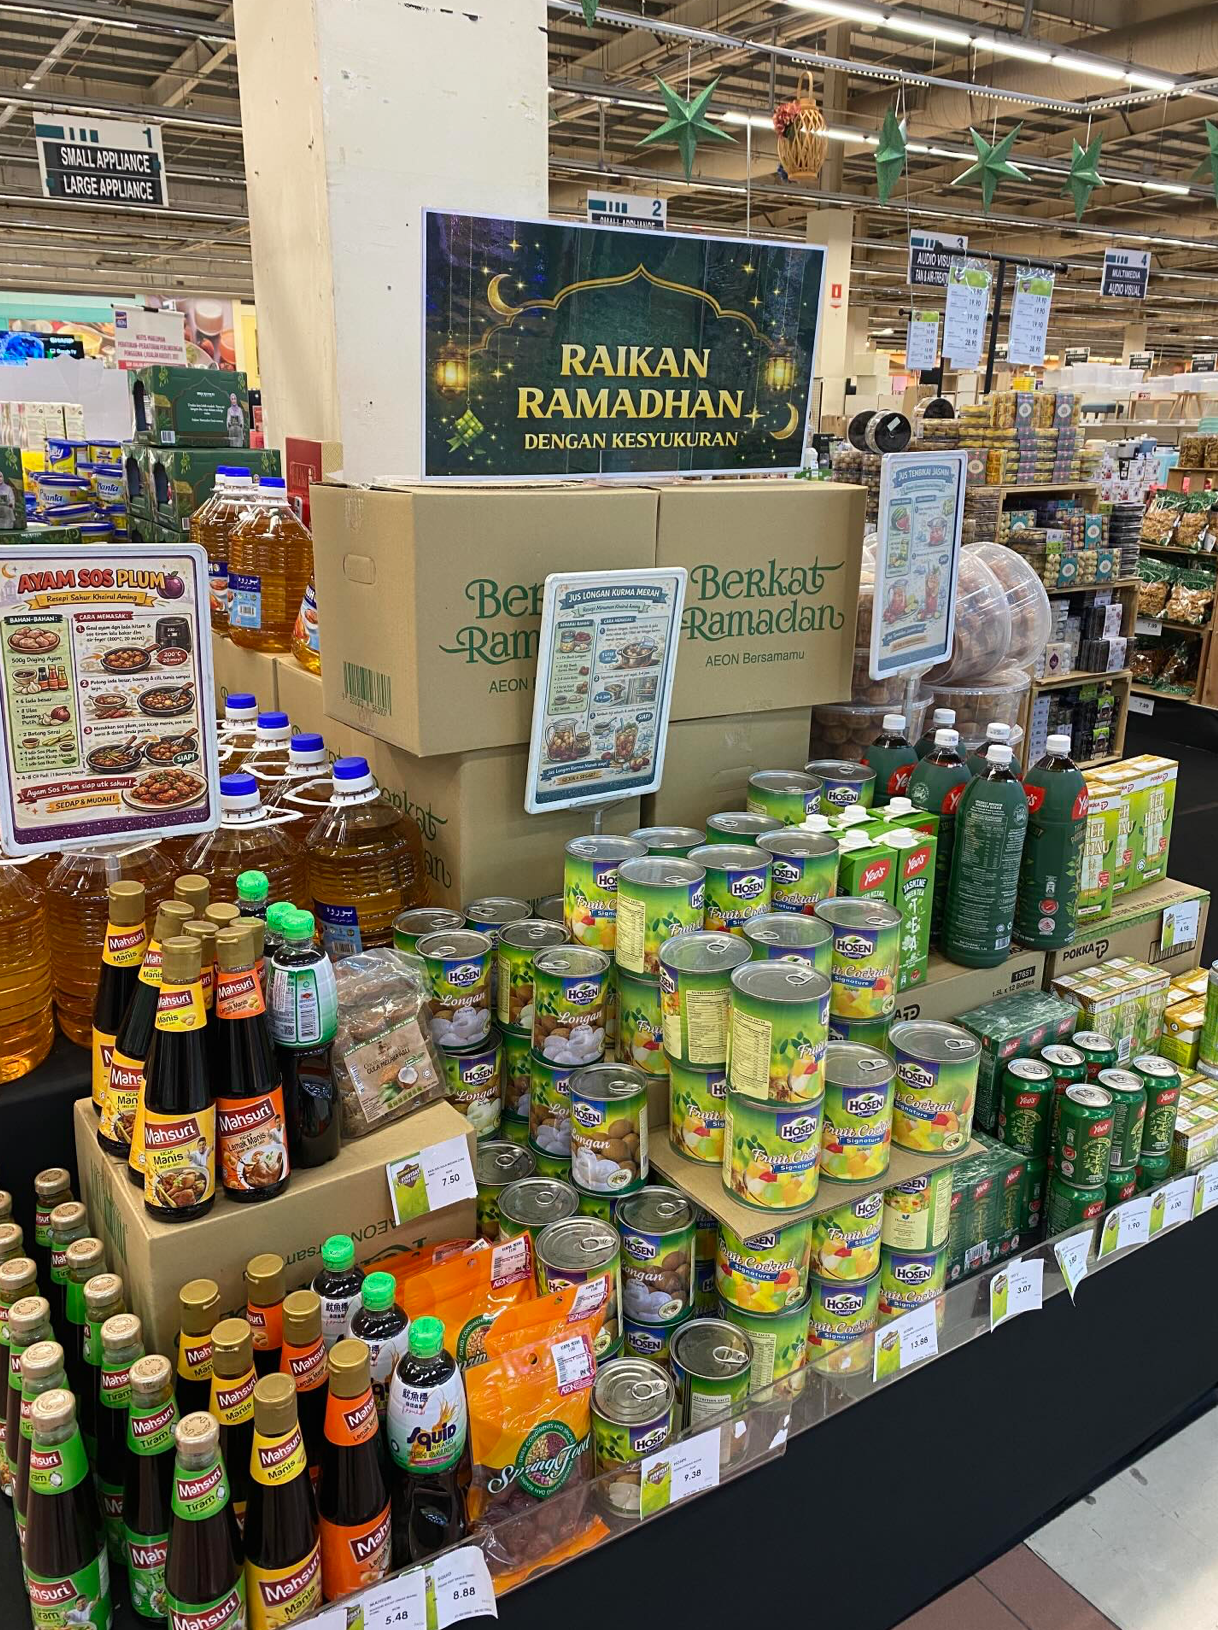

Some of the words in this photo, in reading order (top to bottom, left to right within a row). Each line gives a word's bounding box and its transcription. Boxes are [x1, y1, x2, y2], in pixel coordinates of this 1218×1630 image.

[142, 127, 152, 148] 1
[61, 146, 95, 169] SMALL
[96, 151, 151, 173] APPLIANCE
[63, 174, 98, 196] LARGE
[99, 178, 154, 200] APPLIANCE
[652, 200, 662, 217] 2
[957, 237, 964, 248] 3
[917, 252, 936, 266] AUDIO
[1141, 254, 1147, 266] 4
[1111, 268, 1141, 280] MULTIMEDIA
[1108, 283, 1124, 296] AUDIO
[1124, 285, 1141, 297] VISUAL
[560, 344, 711, 379] RAIKAN
[517, 387, 744, 419] RAMADHAN
[525, 432, 607, 450] DENGAN
[611, 431, 739, 449] KESYUKURAN
[898, 472, 908, 482] JUS
[908, 470, 931, 480] TEMBIKAI
[932, 469, 950, 478] JASMIN
[18, 569, 75, 594] AYAM
[77, 568, 114, 588] SOS
[116, 569, 166, 590] PLUM
[690, 556, 846, 600] Berkat
[46, 594, 69, 602] Resepi
[70, 593, 92, 601] Sahur
[92, 592, 116, 600] Khairul
[116, 593, 138, 603] Aming
[569, 592, 582, 602] JUS
[582, 590, 610, 600] LONGAN
[612, 588, 636, 597] KURMA
[636, 587, 660, 597] MERAH
[680, 600, 844, 641] Ramadan
[705, 653, 740, 668] AEON
[743, 650, 805, 666] Bersamamu
[489, 677, 528, 695] AEON
[177, 754, 195, 762] SIAP!
[27, 788, 47, 798] Ayam
[62, 784, 80, 793] Plum
[82, 782, 96, 791] siap
[97, 780, 108, 788] utk
[110, 780, 132, 788] sahur!
[828, 792, 858, 802] HOSEN
[56, 799, 80, 809] SEDAP
[86, 795, 116, 804] MUDAH!
[1149, 792, 1165, 808] TEH
[1144, 811, 1168, 827] HIJAU
[907, 854, 926, 874] Yeo's
[865, 866, 886, 886] Yeo's
[734, 883, 764, 896] HOSEN
[903, 879, 927, 894] JASMINE
[576, 895, 606, 910] Fruit
[774, 890, 820, 904] Cocktail
[708, 906, 740, 919] Fruit
[109, 932, 145, 951] Mahsuri
[838, 940, 871, 953] HOSEN
[113, 951, 137, 962] Manis
[1063, 944, 1095, 962] POKKA
[450, 968, 480, 983] HOSEN
[845, 965, 890, 979] Cocktail
[218, 978, 253, 998] Mahsuri
[835, 976, 869, 986] Signature
[1016, 979, 1034, 990] Bottles
[440, 992, 486, 1007] Longan
[567, 988, 598, 1001] HOSEN
[558, 1010, 602, 1026] Longan
[367, 1064, 380, 1075] GULA
[464, 1068, 494, 1084] HOSEN
[899, 1066, 932, 1086] HOSEN
[456, 1086, 498, 1102] Longan
[1020, 1094, 1036, 1106] Yeo's
[1160, 1092, 1176, 1103] Yeo's
[849, 1099, 883, 1111] HOSEN
[894, 1100, 928, 1118] Signature
[904, 1094, 955, 1112] Cocktail
[220, 1104, 272, 1132] Mahsuri
[572, 1108, 600, 1124] HOSEN
[686, 1105, 720, 1121] Fruit
[146, 1123, 195, 1145] Mahsuri
[782, 1120, 816, 1137] HOSEN
[822, 1122, 856, 1137] Fruit
[1094, 1122, 1110, 1136] Yeo's
[227, 1138, 247, 1152] Lemak
[247, 1132, 266, 1146] Manis
[154, 1153, 184, 1166] Manis
[752, 1149, 789, 1164] Fruit
[780, 1161, 814, 1172] Signature
[442, 1174, 460, 1187] 7.50
[828, 1228, 863, 1240] Fruit
[1128, 1222, 1140, 1230] 1.90
[624, 1240, 655, 1256] HOSEN
[734, 1264, 772, 1280] Signature
[744, 1257, 796, 1275] Cocktail
[896, 1268, 931, 1282] HOSEN
[1018, 1284, 1031, 1294] 3.07
[825, 1298, 862, 1311] HOSEN
[629, 1334, 660, 1350] HOSEN
[910, 1336, 929, 1350] 13.88
[292, 1344, 326, 1375] Mahsuri
[219, 1378, 256, 1407] Mahsuri
[225, 1402, 252, 1421] Manis
[134, 1406, 174, 1434] Mahsuri
[140, 1430, 168, 1448] Tiram
[432, 1438, 454, 1450] BRAND
[636, 1429, 667, 1450] HOSEN
[261, 1434, 300, 1465] Mahsuri
[268, 1460, 296, 1480] Manis
[488, 1458, 560, 1494] Spring
[549, 1431, 592, 1478] Food
[179, 1469, 222, 1498] Mahsuri
[684, 1469, 702, 1482] 9.38
[186, 1494, 215, 1512] Tiram
[264, 1552, 320, 1602] Mahsuri
[284, 1586, 316, 1614] Manis
[453, 1587, 476, 1600] 8.88
[174, 1598, 237, 1630] Mahsuri
[385, 1611, 408, 1625] 5.48
